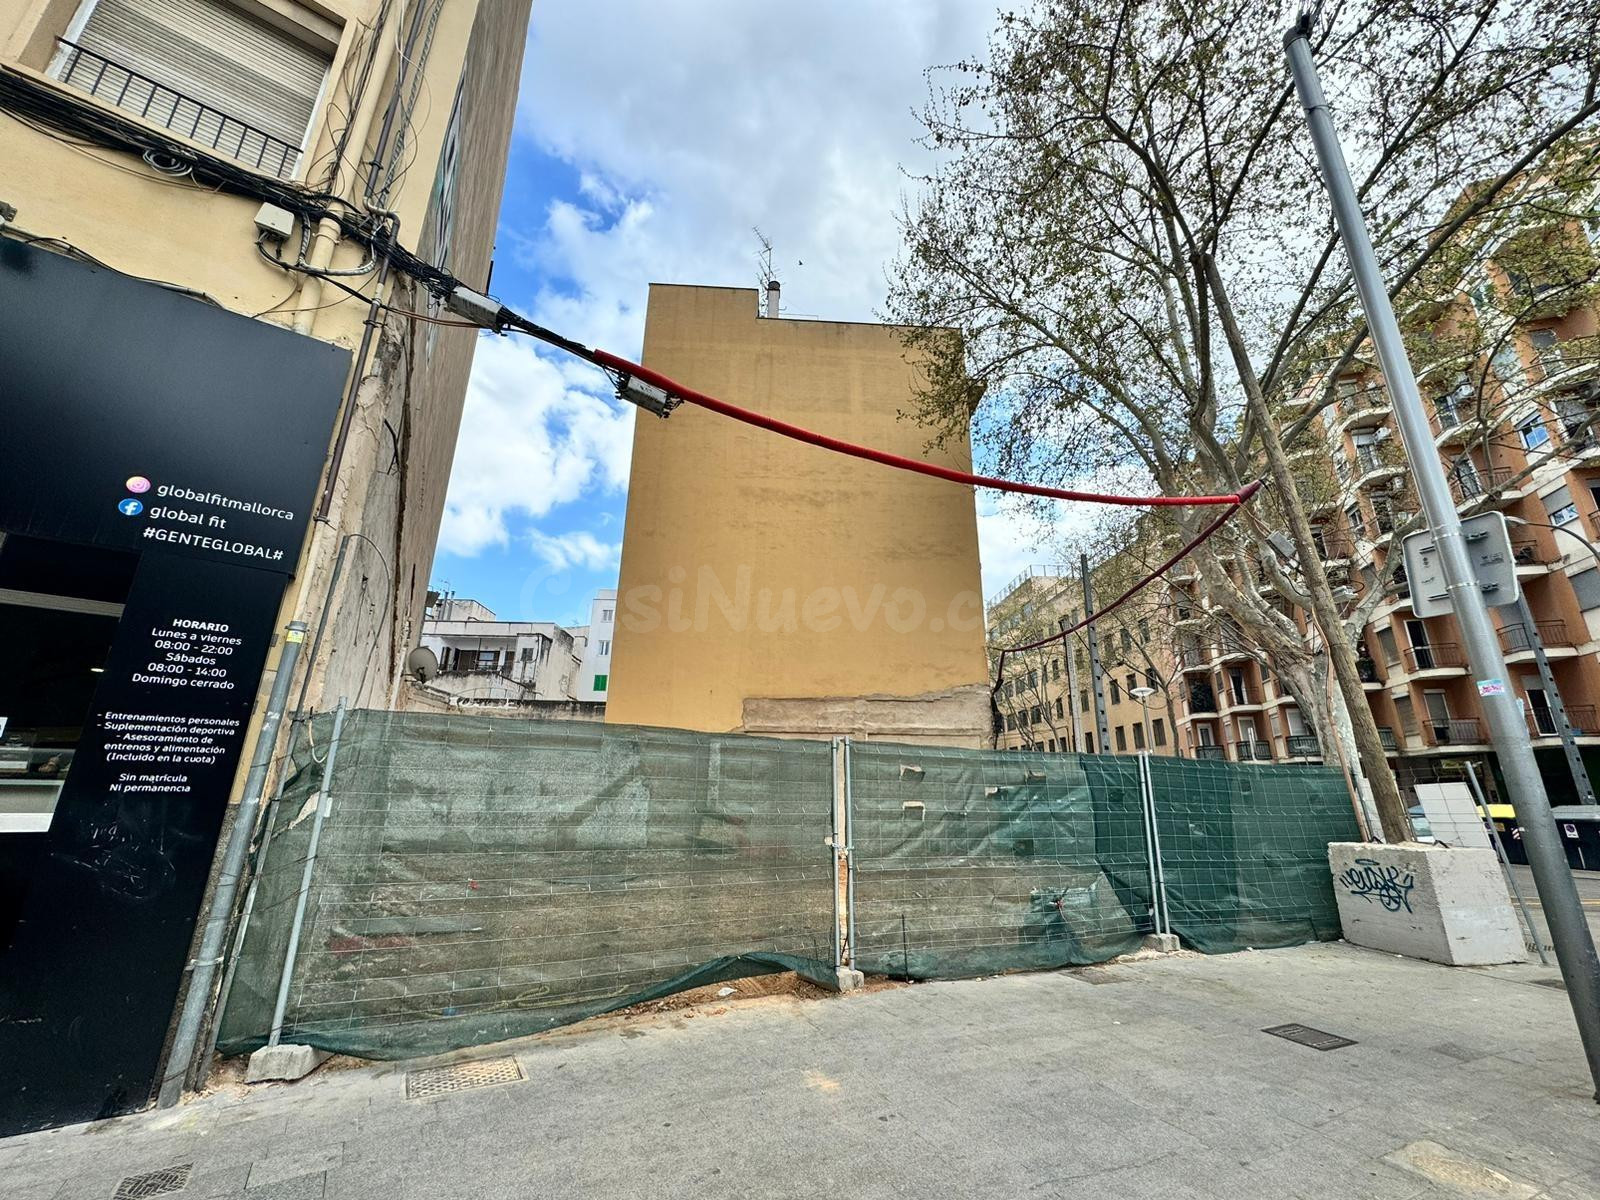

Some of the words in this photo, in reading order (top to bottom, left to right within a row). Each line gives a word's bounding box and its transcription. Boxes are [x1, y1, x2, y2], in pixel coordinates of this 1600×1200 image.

[157, 485, 294, 520] globalfitmallorca
[149, 506, 203, 525] global
[209, 515, 227, 529] fit
[143, 527, 283, 560] #GENTEGLOBAL#
[173, 618, 229, 632] HORARIO
[151, 628, 187, 640] Lunes
[200, 634, 242, 645] viernes
[154, 639, 190, 651] 08:00
[201, 645, 233, 655] 22:00
[165, 652, 216, 665] Sábados
[147, 663, 184, 674] 08:00
[195, 667, 227, 677] 14:00
[132, 673, 187, 687] Domingo
[190, 678, 235, 690] cerrado
[105, 711, 186, 724] Entrenamientos
[188, 716, 240, 727] personales
[104, 721, 187, 734] Suplementación
[189, 725, 235, 736] deportiva
[123, 733, 199, 744] Asesoramiento
[201, 736, 213, 744] de
[104, 743, 151, 752] entrenos
[154, 745, 160, 753] y
[162, 744, 226, 754] alimentación
[172, 754, 182, 762] la
[184, 755, 216, 764] cuota)
[119, 773, 136, 782] Sin
[139, 773, 188, 783] matrícula
[109, 784, 121, 792] Ni
[123, 784, 191, 793] permanencia
